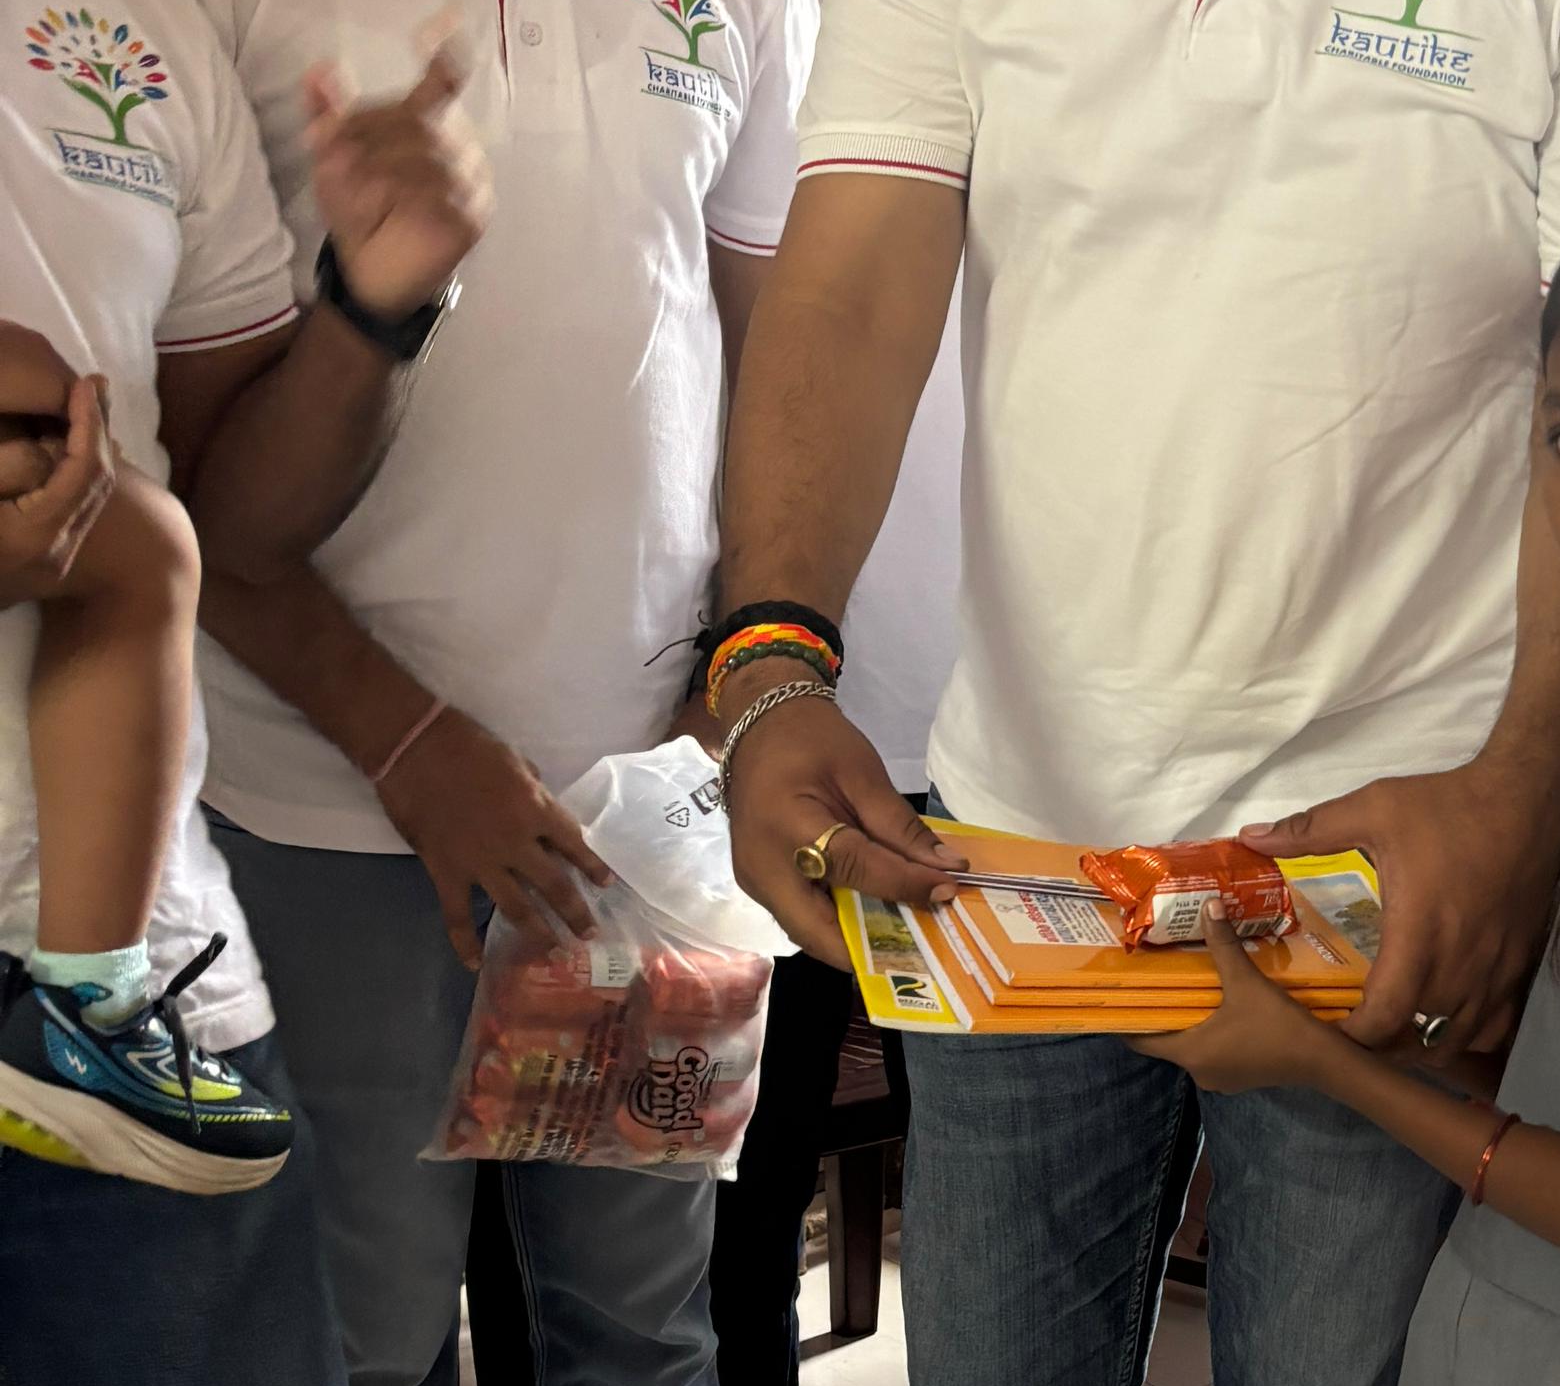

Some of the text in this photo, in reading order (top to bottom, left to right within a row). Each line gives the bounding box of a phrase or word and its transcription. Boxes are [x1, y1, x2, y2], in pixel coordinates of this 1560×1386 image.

[1324, 44, 1467, 86] CHARITABLE FOUNDATION
[1330, 12, 1475, 74] kautike
[671, 1045, 709, 1130] Good
